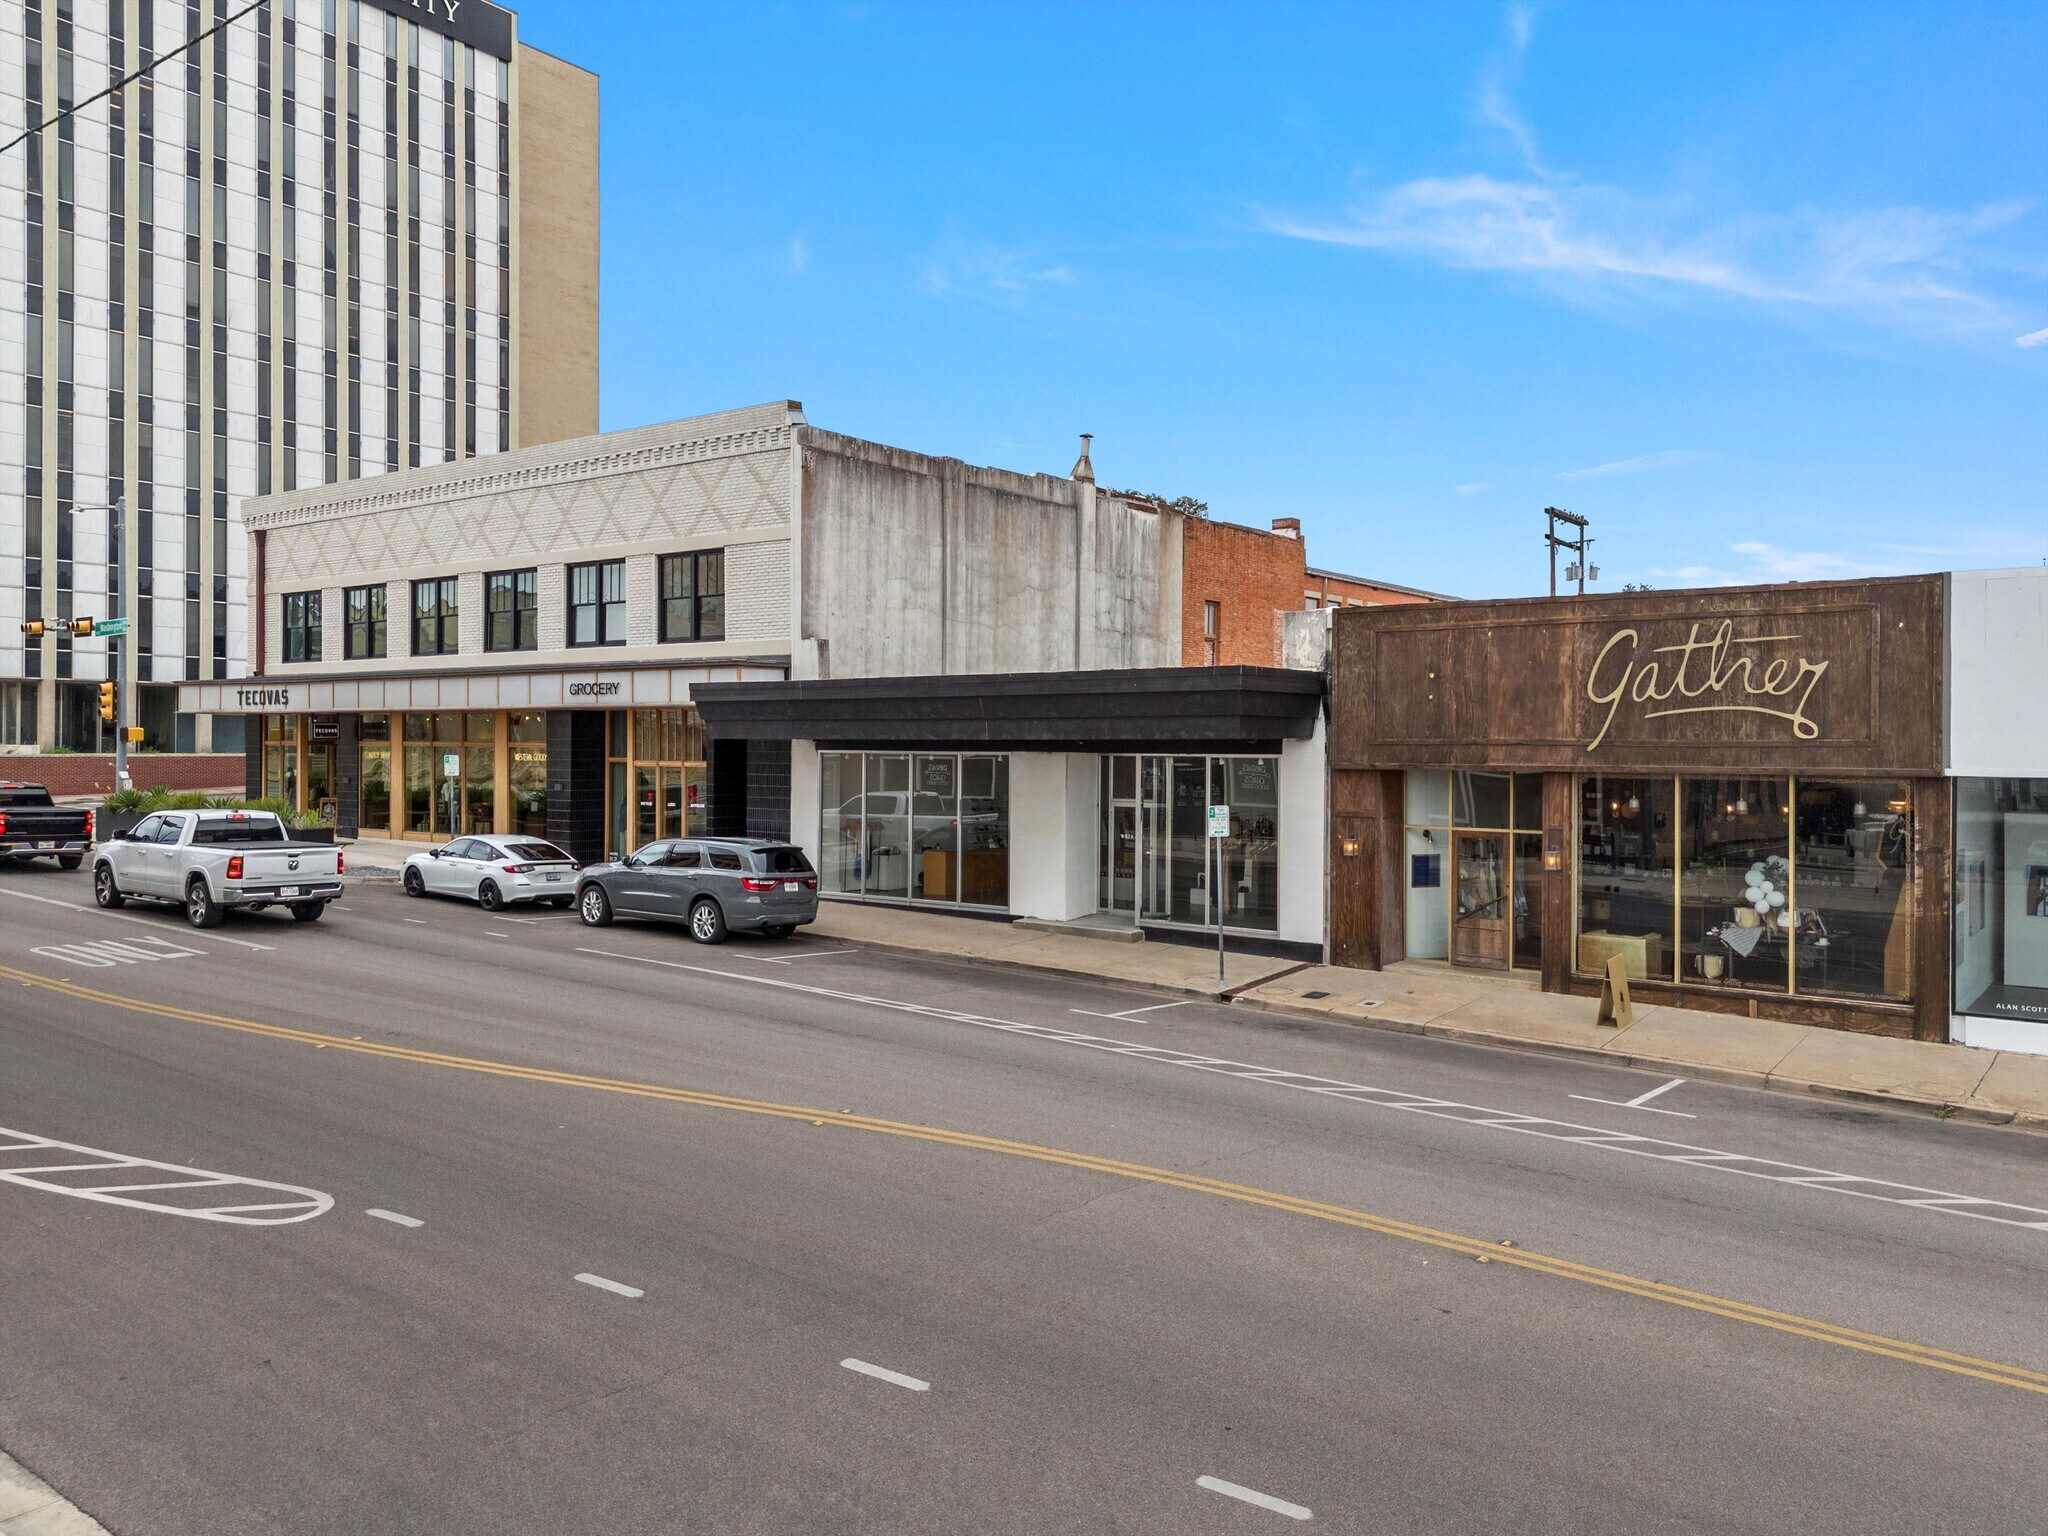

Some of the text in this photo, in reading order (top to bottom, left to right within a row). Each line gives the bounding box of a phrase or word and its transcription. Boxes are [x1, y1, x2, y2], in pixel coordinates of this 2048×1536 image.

[569, 681, 621, 697] GROCERY
[1586, 618, 1828, 751] Gather
[237, 689, 289, 707] TECOVAS
[29, 935, 210, 968] ONLY
[1996, 1002, 2048, 1014] ALAN SCOTT
